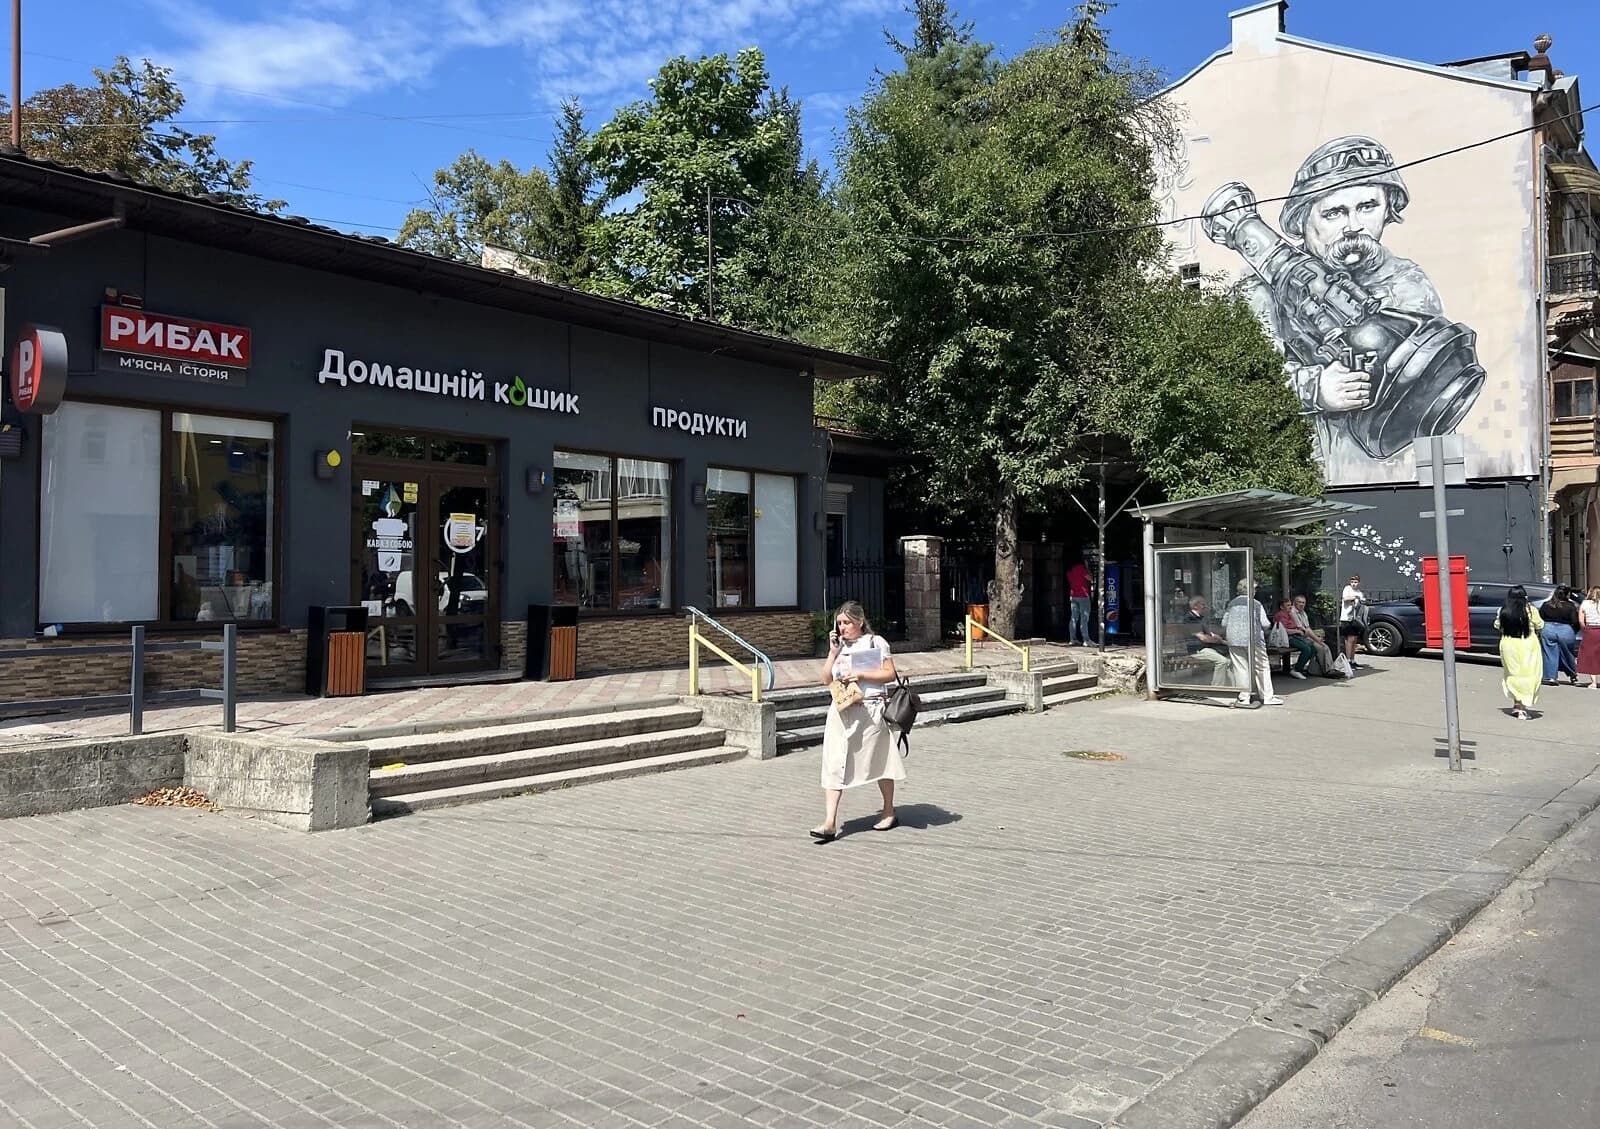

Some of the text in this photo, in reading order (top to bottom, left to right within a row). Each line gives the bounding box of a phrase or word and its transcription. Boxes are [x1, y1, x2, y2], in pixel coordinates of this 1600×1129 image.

[109, 314, 244, 359] РИБАК
[119, 356, 229, 380] М'ЯСНА ІСТОРІЯ
[318, 348, 580, 415] Домашній кошик
[653, 406, 748, 438] ПРОДУКТИ
